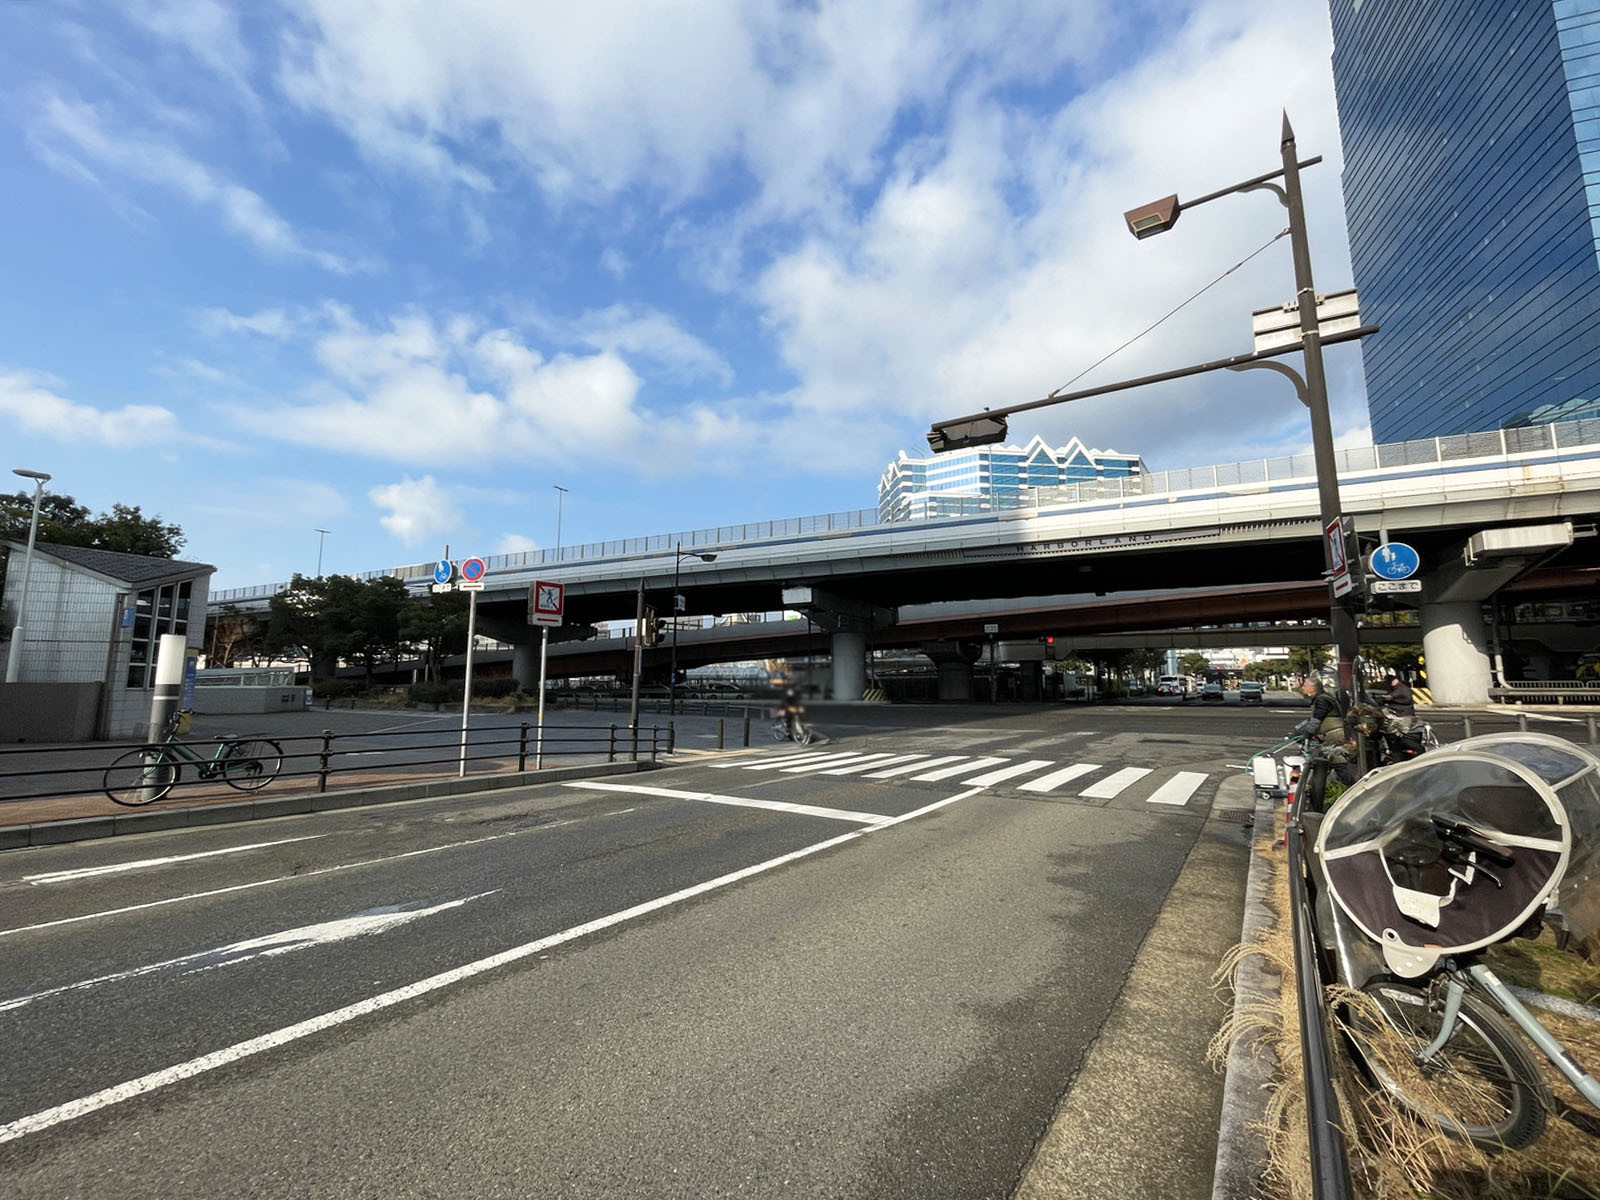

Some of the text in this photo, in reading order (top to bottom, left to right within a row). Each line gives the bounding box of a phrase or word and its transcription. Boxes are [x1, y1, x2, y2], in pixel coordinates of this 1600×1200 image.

[1016, 534, 1152, 552] HARBORLAND
[1377, 582, 1418, 591] ここまで
